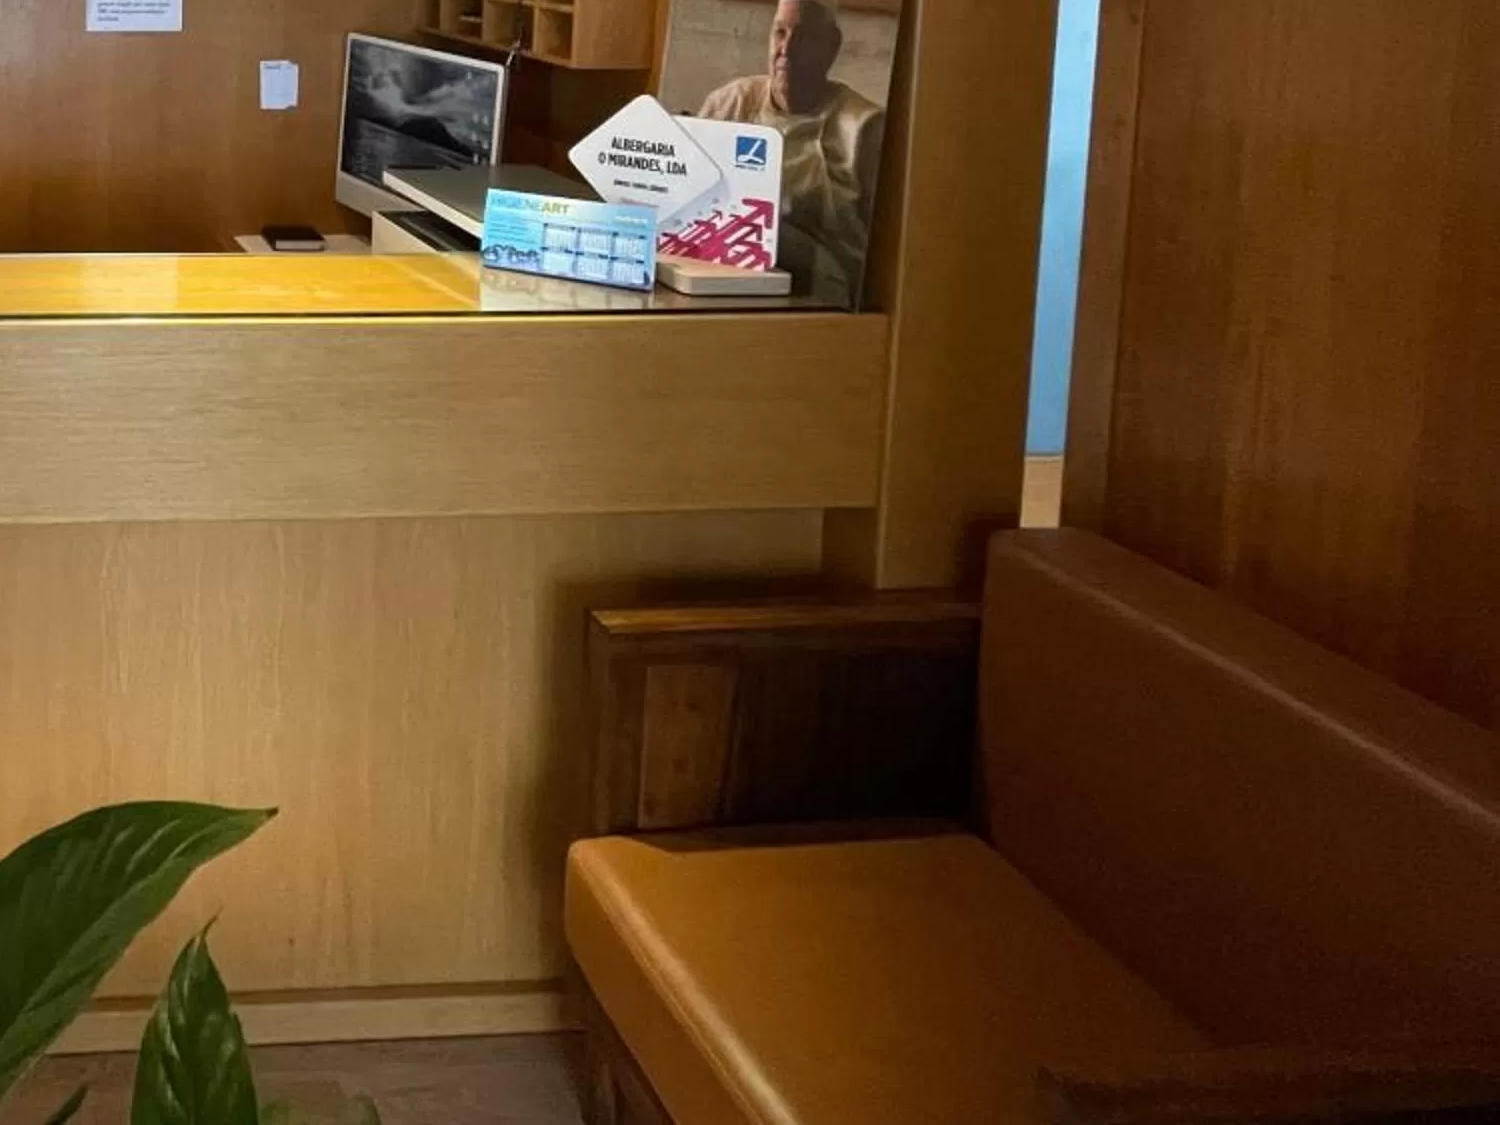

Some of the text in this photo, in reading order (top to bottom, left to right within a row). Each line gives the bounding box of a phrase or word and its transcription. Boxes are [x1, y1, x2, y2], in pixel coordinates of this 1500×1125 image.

[611, 136, 675, 156] ALBERGARIA
[598, 151, 607, 164] O
[666, 161, 688, 177] LDA
